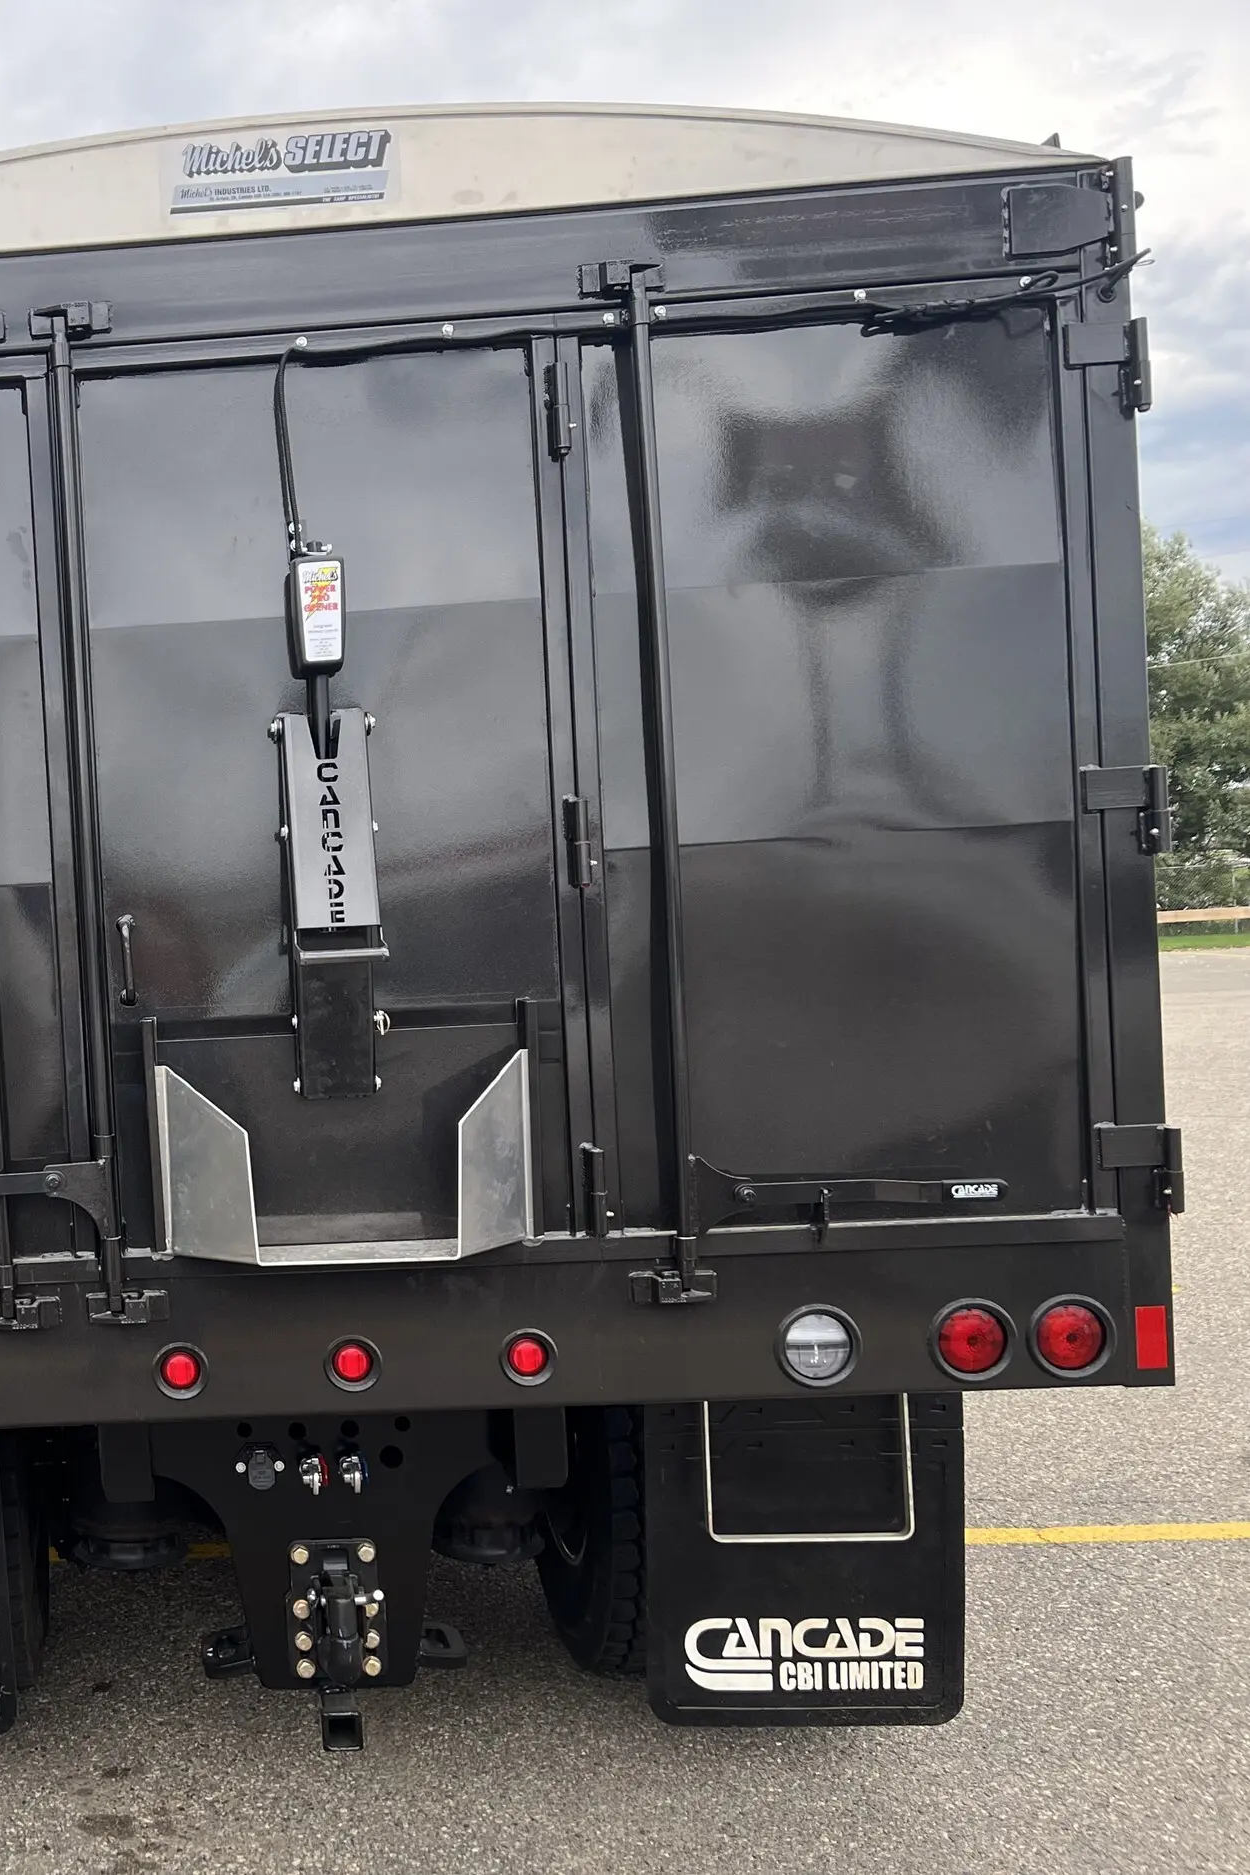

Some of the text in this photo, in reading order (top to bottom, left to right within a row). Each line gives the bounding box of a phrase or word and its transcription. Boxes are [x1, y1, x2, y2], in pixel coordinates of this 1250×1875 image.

[182, 129, 392, 178] Michel's SELECT
[214, 185, 256, 196] INDUSTRIES
[257, 184, 272, 193] LTD.
[304, 584, 337, 594] POWER
[304, 602, 339, 612] OPENER
[316, 761, 346, 924] CANCADE
[951, 1184, 998, 1197] CANCADE
[684, 1617, 925, 1671] CANCADE
[779, 1661, 924, 1691] CBI LIMITED
